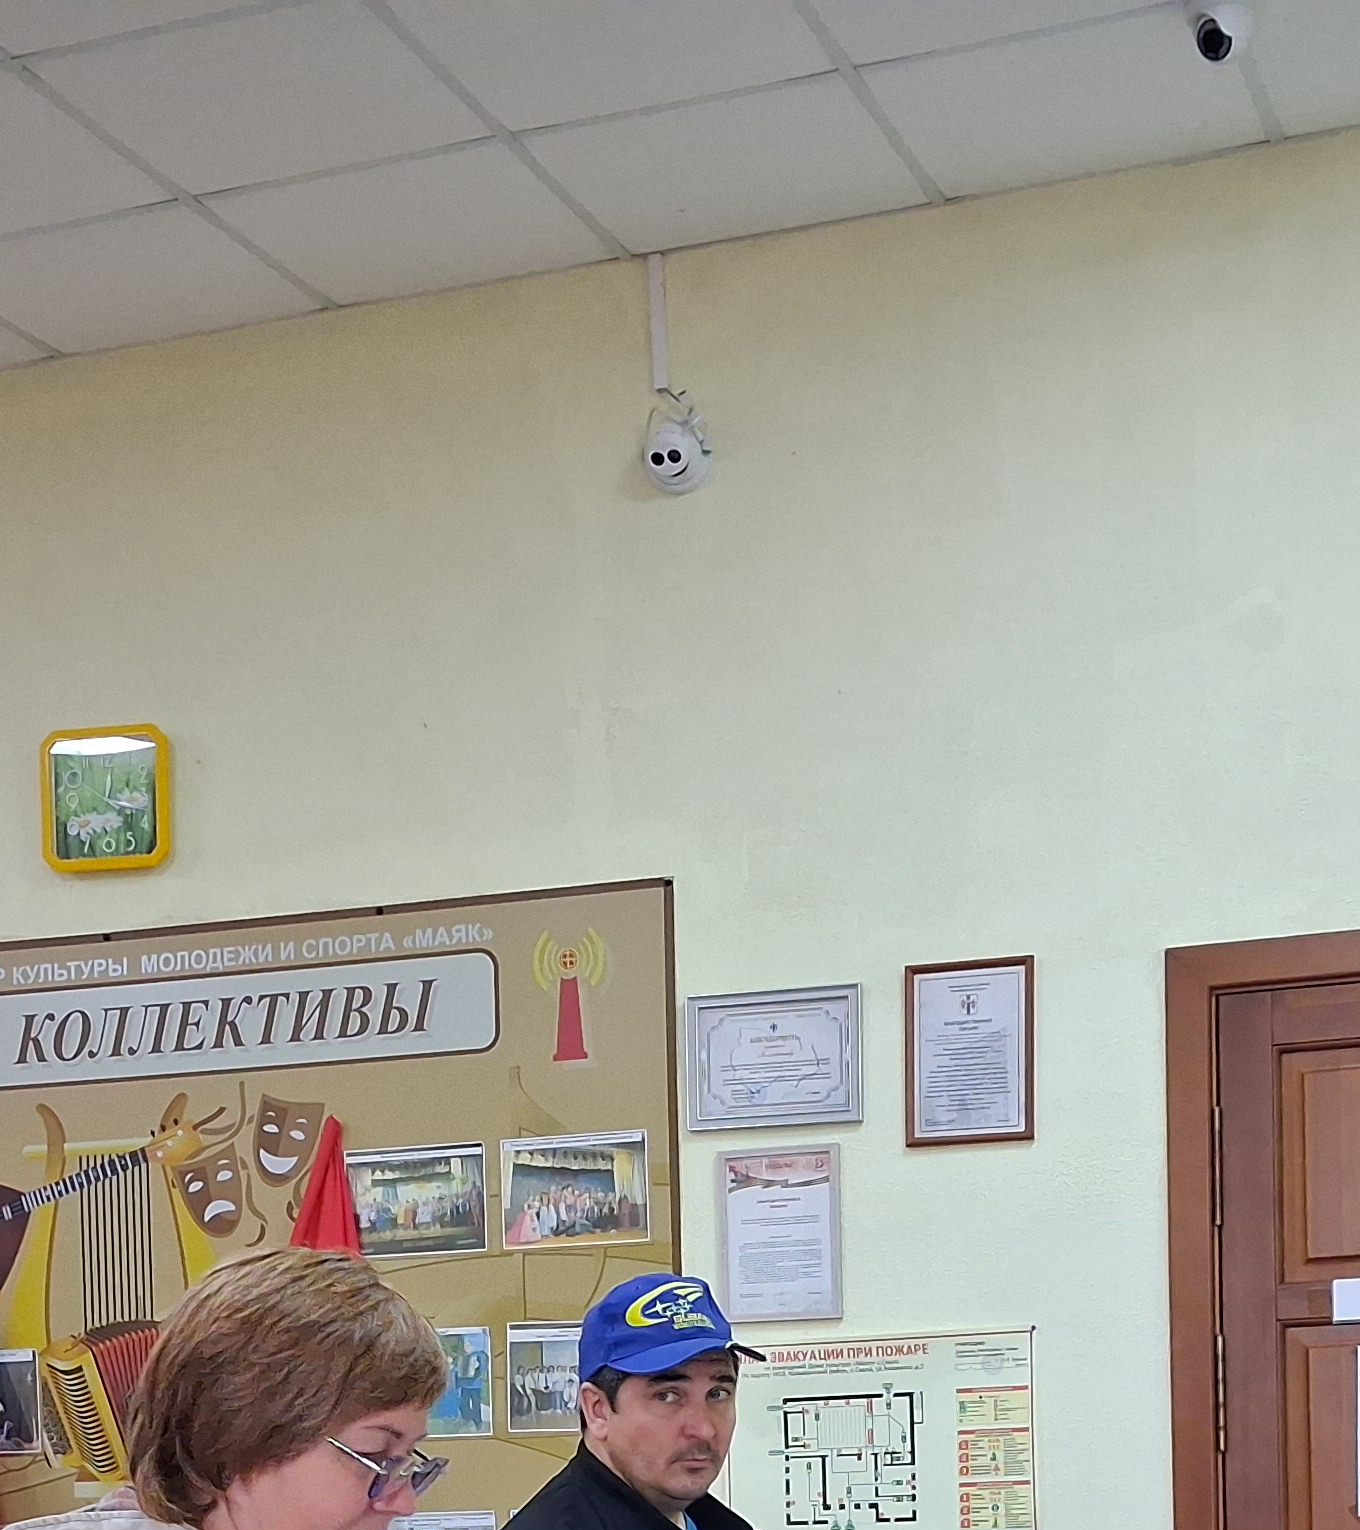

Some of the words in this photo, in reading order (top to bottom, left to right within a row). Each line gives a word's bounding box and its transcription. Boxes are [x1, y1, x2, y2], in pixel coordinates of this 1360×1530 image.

[57, 769, 82, 793] 10
[139, 764, 150, 784] 2
[65, 792, 79, 811] 9
[141, 813, 149, 831] 4
[83, 835, 91, 854] 7
[102, 837, 116, 853] 6
[126, 831, 136, 851] 5
[11, 956, 129, 984] КУЛЬТУРЫ
[140, 942, 273, 974] МОЛОДЕЖИ
[280, 938, 295, 960] И
[302, 932, 395, 959] СПОРТА
[402, 922, 493, 949] «МАЯК»
[12, 978, 439, 1067] КОЛЛЕКТИВЫ
[770, 1348, 844, 1364] ЭВАКУАЦИИ
[847, 1346, 873, 1358] ПРИ
[875, 1343, 930, 1357] ПОЖАРЕ
